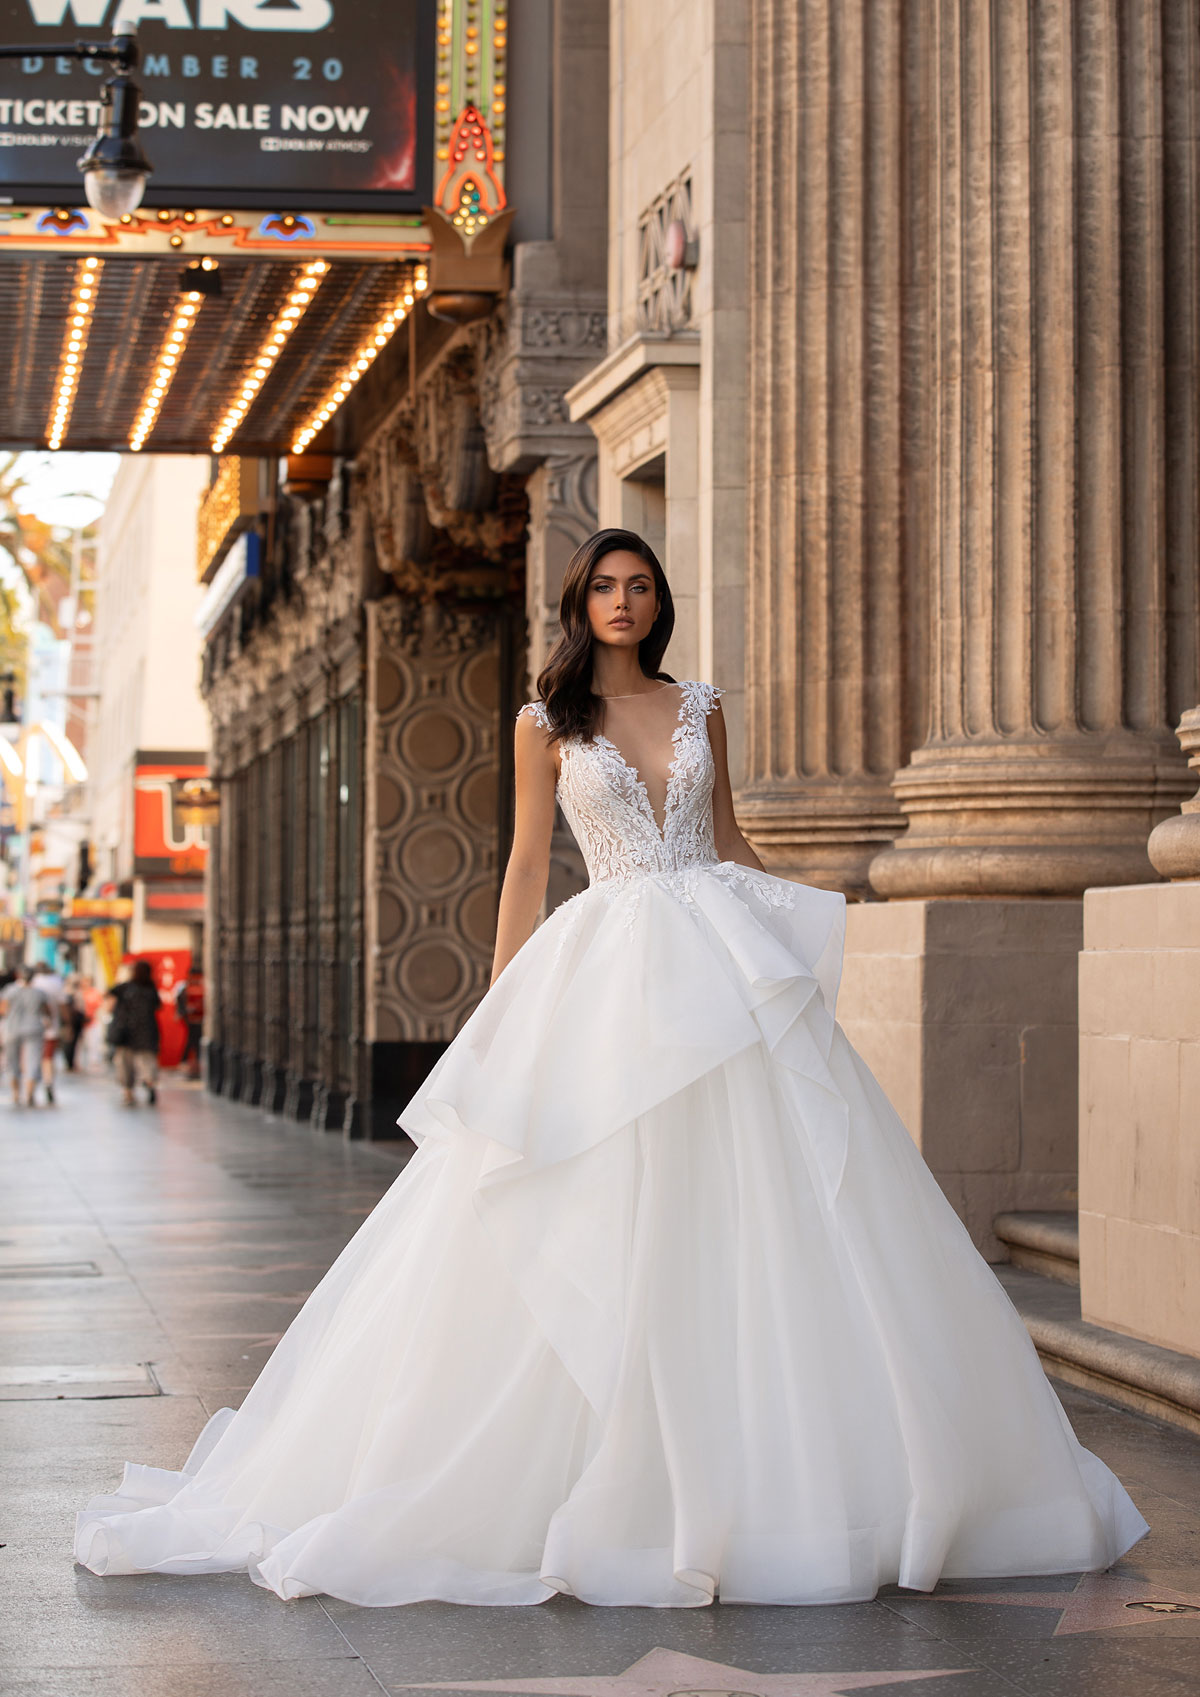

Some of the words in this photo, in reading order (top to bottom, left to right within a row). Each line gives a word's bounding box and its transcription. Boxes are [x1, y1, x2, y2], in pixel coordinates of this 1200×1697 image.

[22, 55, 258, 79] DECMBER
[293, 57, 342, 81] 20
[0, 99, 101, 126] TICKET
[137, 102, 186, 128] ON
[194, 103, 271, 130] SALE
[280, 104, 370, 133] NOW
